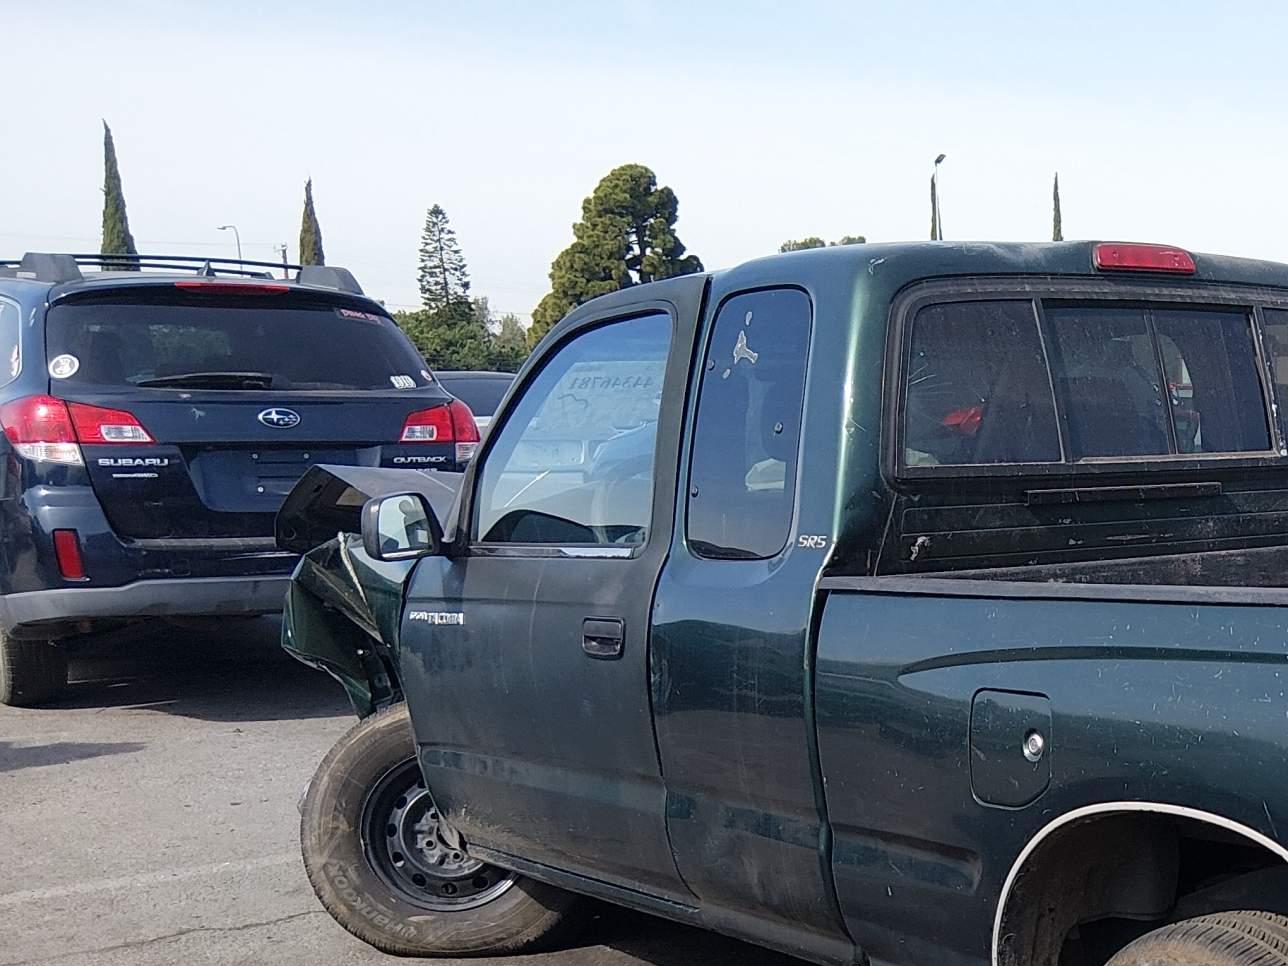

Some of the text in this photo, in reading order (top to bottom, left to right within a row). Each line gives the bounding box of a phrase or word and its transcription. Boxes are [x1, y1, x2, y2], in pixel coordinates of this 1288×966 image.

[98, 458, 169, 467] SUBARU
[393, 456, 447, 464] OUTBACK
[798, 534, 827, 548] SR5
